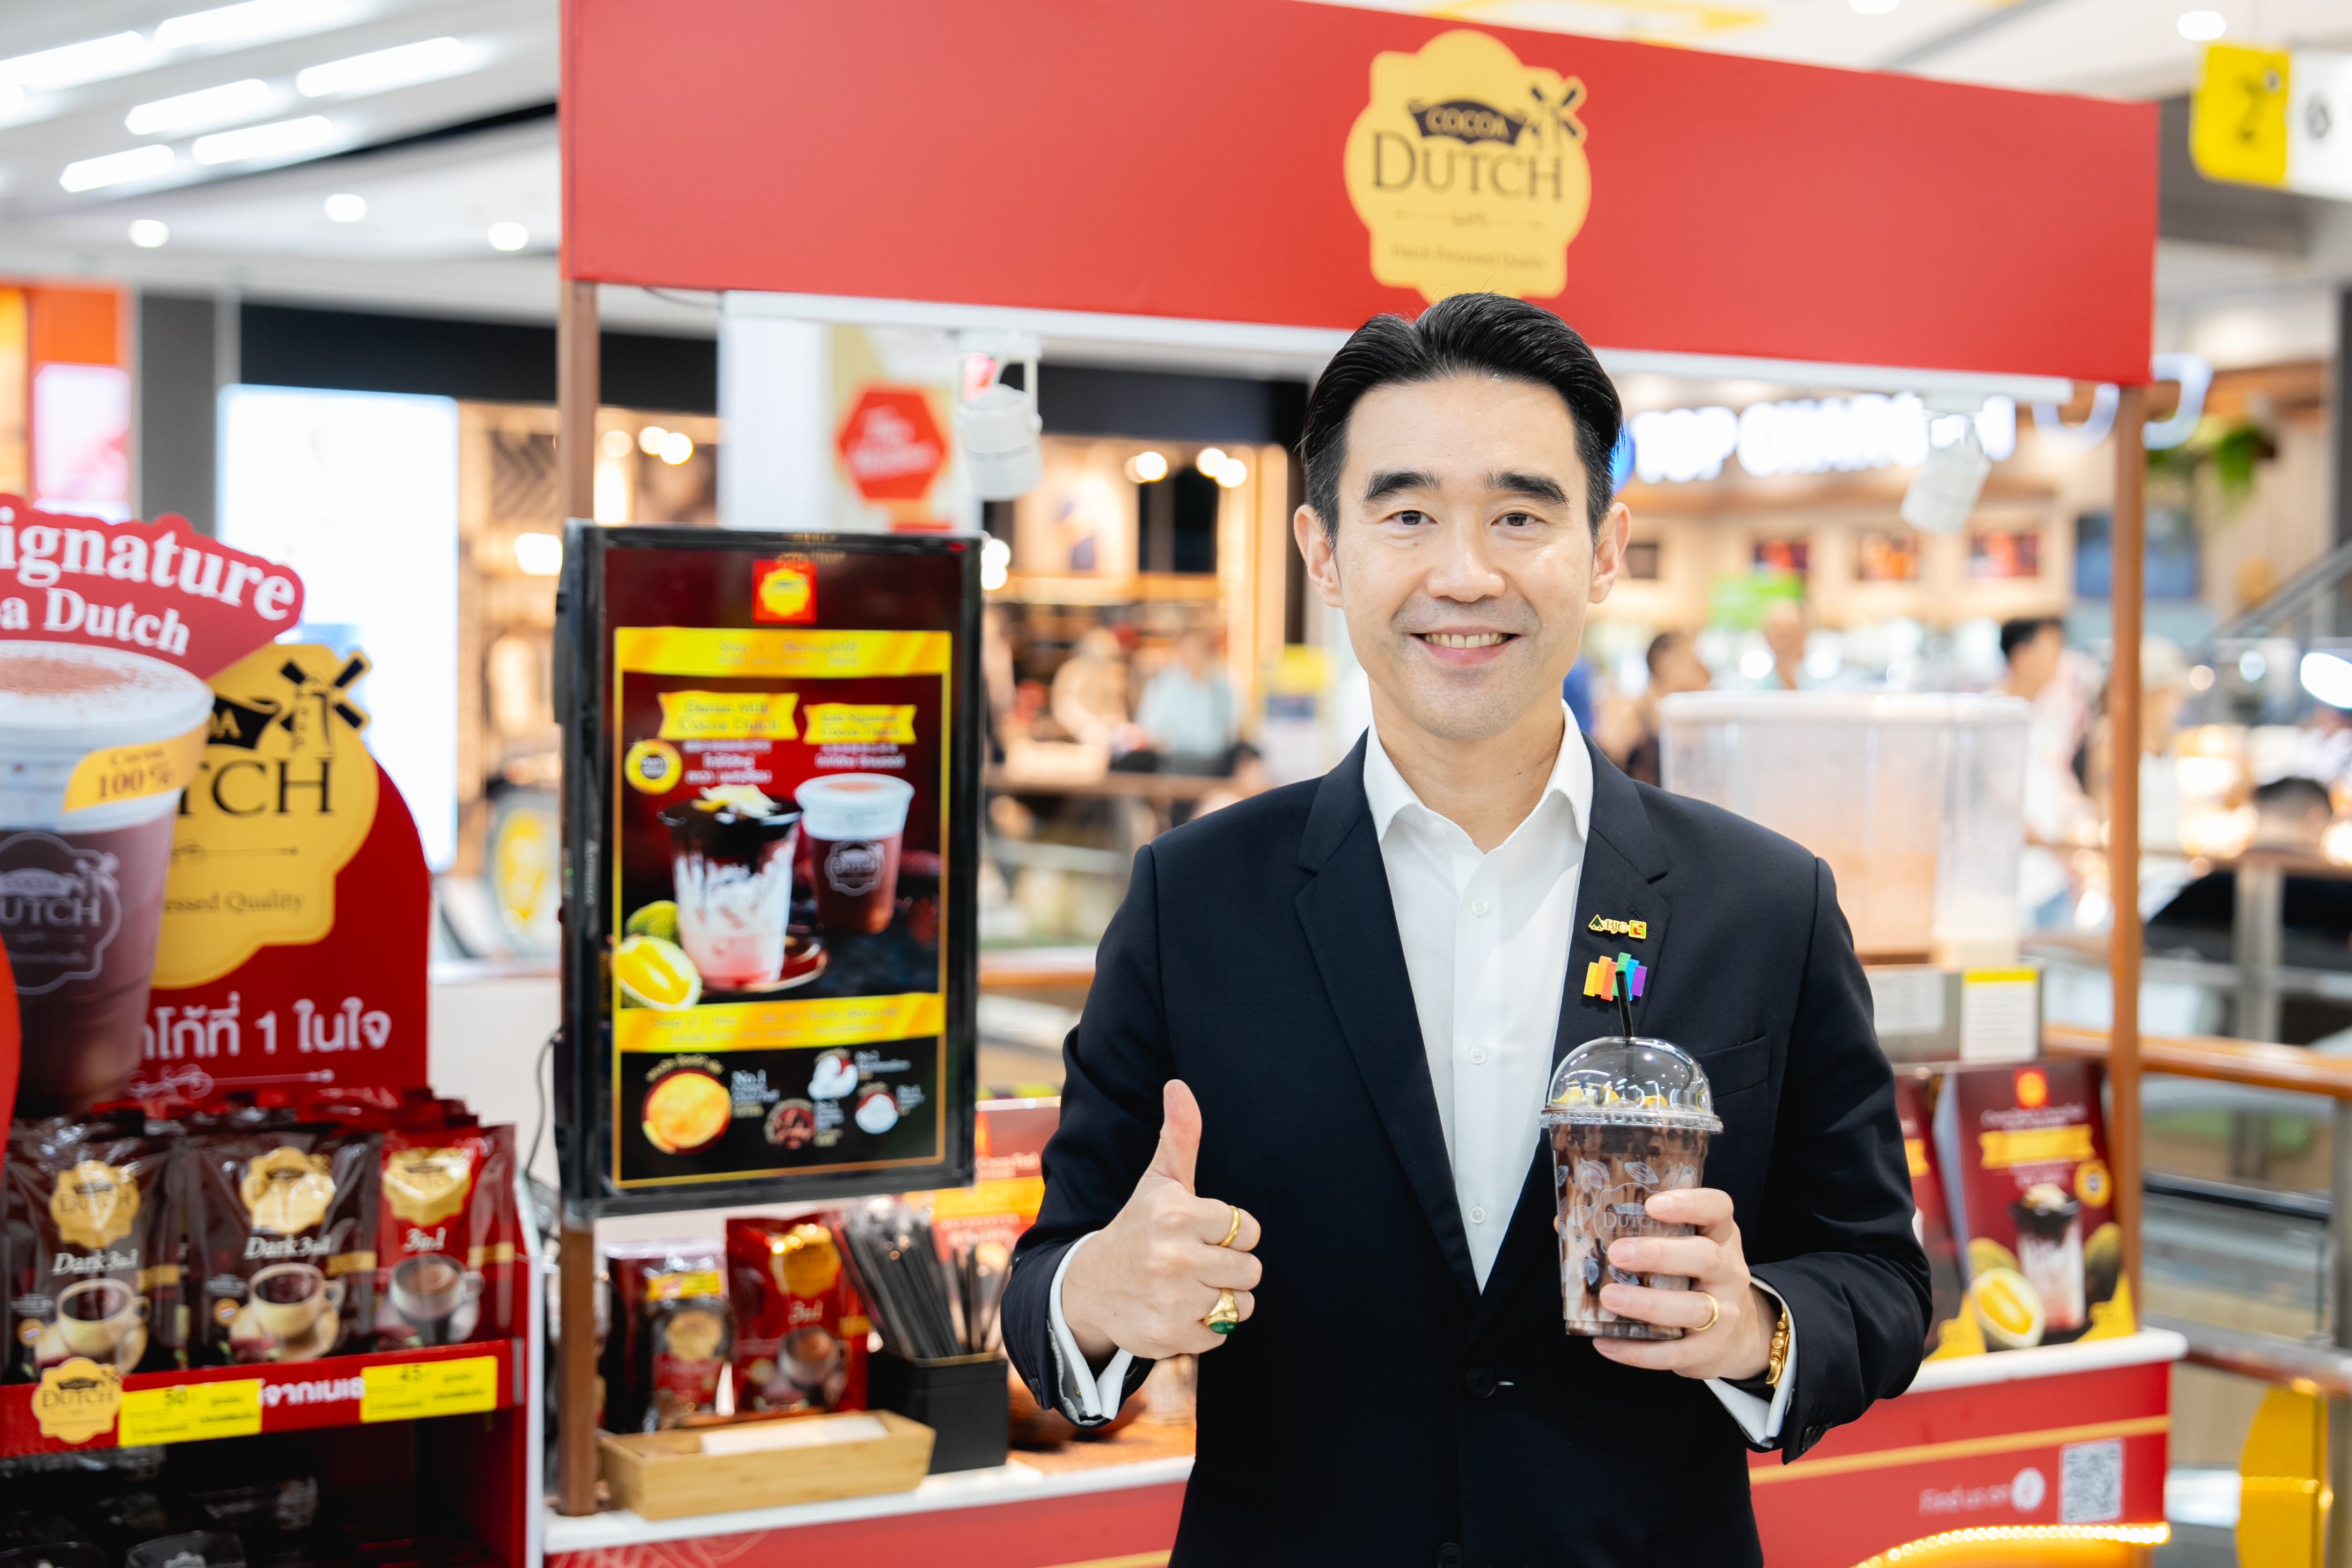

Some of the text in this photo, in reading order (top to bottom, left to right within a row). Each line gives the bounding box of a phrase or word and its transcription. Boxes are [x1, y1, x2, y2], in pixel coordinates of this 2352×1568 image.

[1425, 107, 1510, 140] COCOA
[1372, 132, 1564, 202] DUTCH
[0, 506, 296, 621] ignature
[43, 587, 190, 656] Dutch
[1606, 919, 1627, 933] BJC
[254, 1010, 278, 1056] 1
[292, 996, 392, 1054] ในใจ
[52, 1250, 106, 1276] Dark
[243, 1235, 299, 1260] Dark
